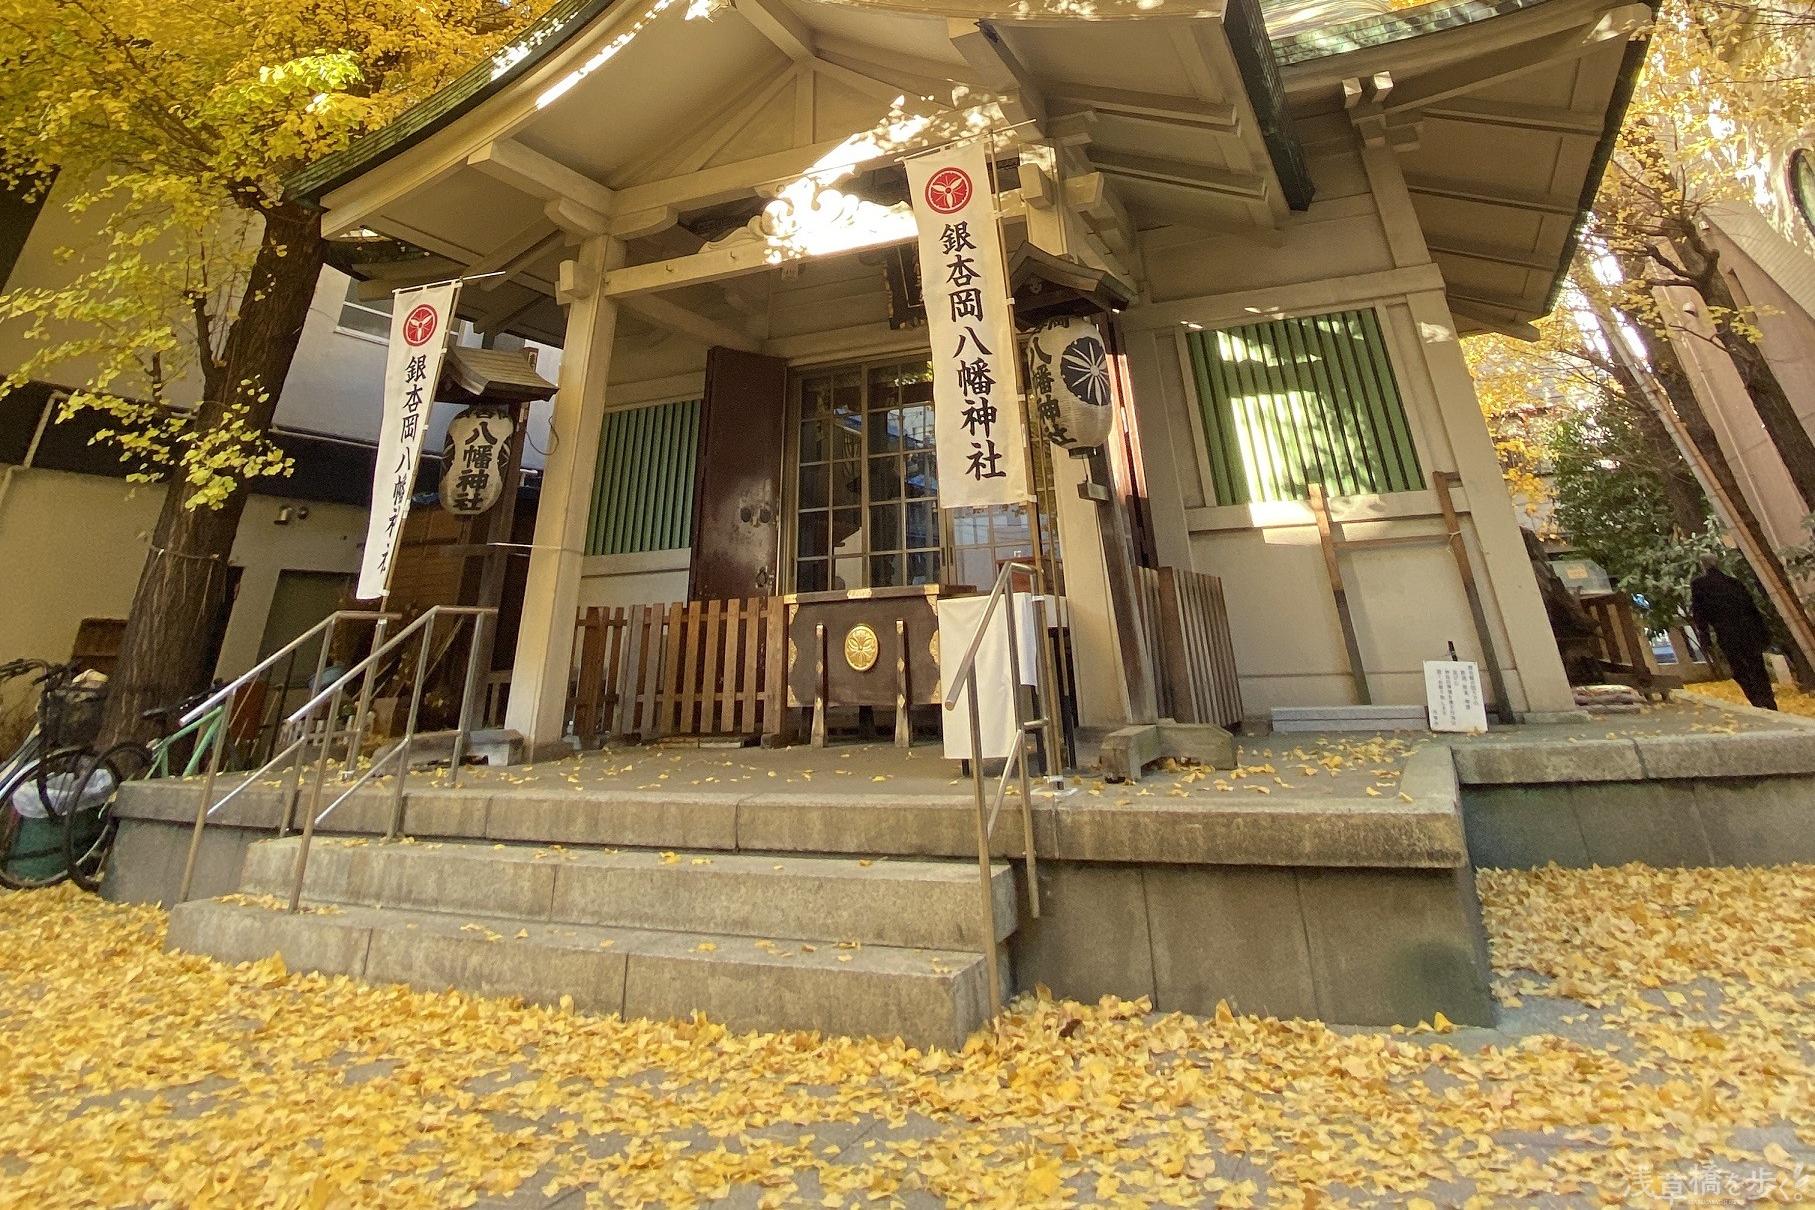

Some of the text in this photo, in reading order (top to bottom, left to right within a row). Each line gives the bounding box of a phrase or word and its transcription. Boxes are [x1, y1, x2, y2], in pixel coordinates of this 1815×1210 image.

[939, 220, 1007, 481] 銀杏岡八幡神社
[452, 421, 498, 511] 八幡神社
